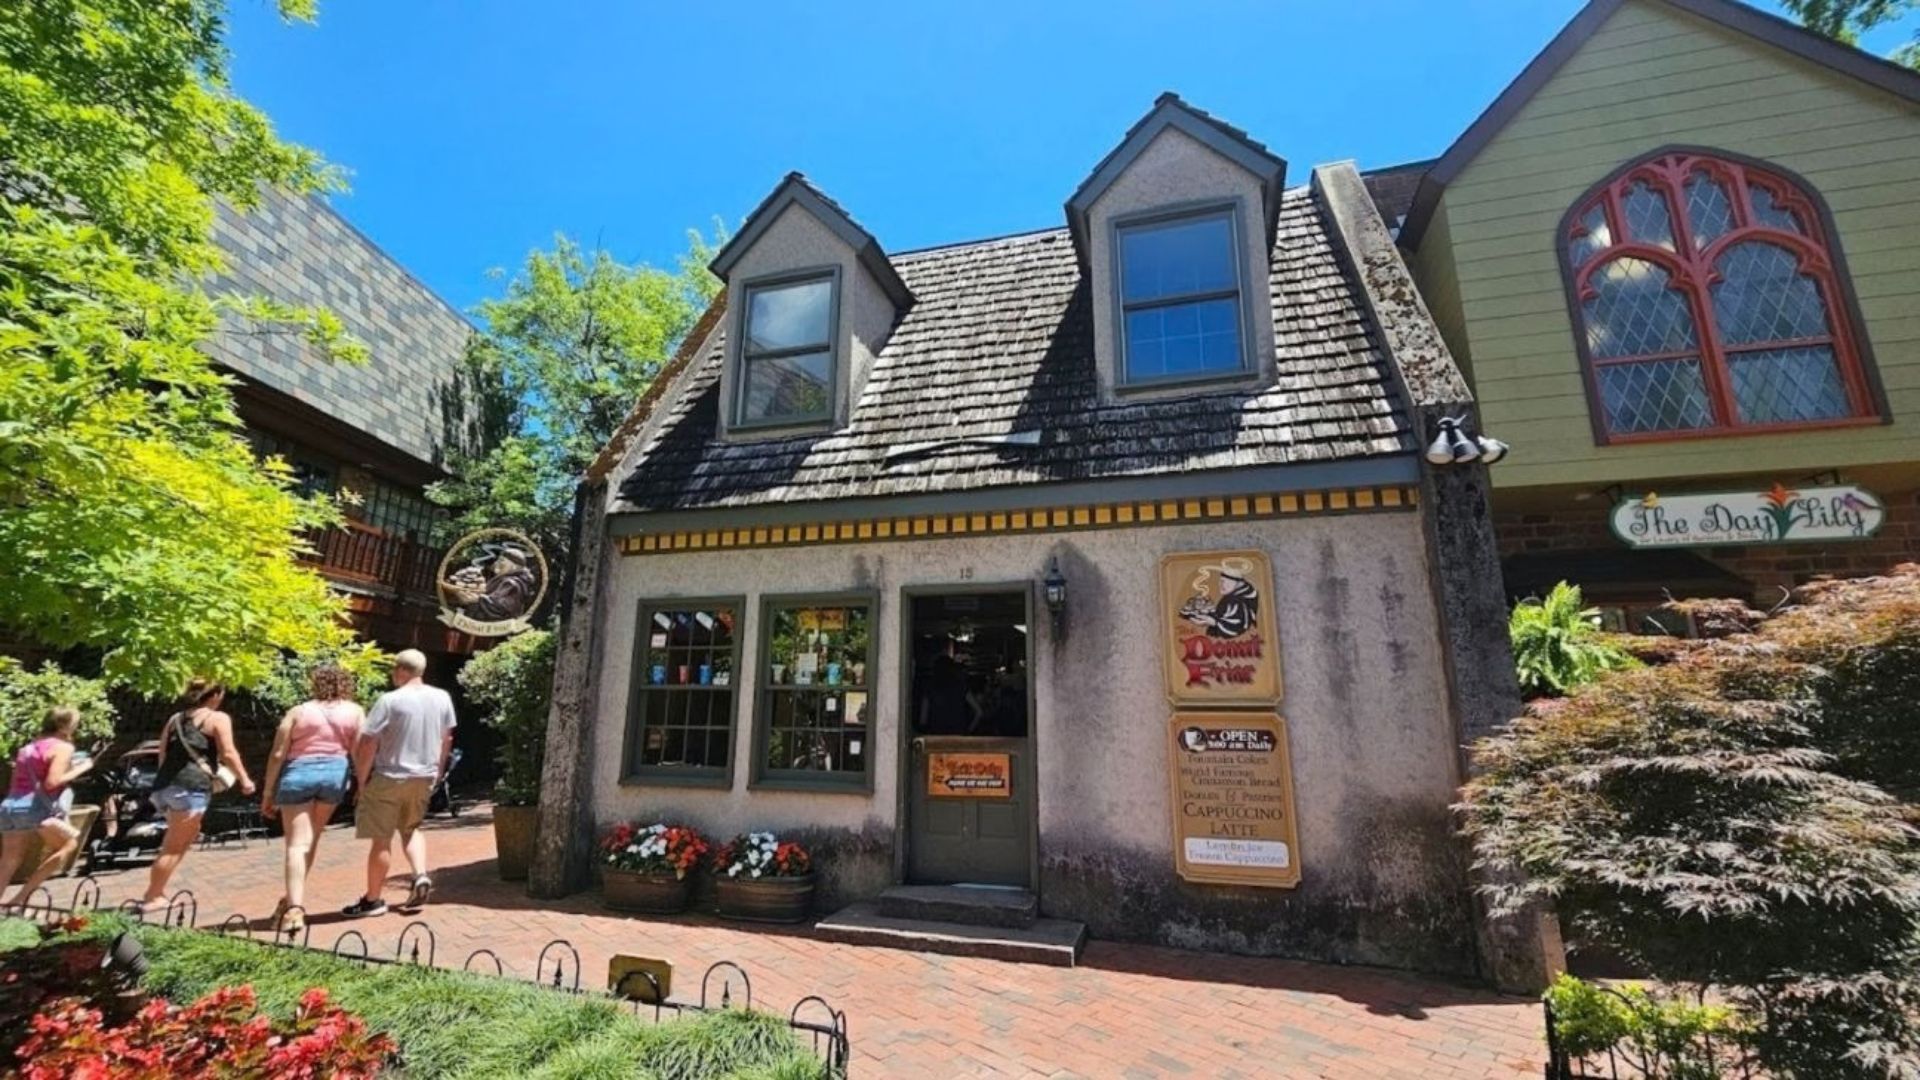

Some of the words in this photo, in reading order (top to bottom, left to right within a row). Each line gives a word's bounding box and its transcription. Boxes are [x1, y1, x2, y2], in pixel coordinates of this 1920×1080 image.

[1630, 503, 1689, 536] The
[1701, 503, 1775, 540] Day
[1796, 497, 1865, 537] Lily
[1179, 632, 1264, 663] Donut
[1185, 660, 1256, 687] Friar
[1220, 730, 1259, 742] OPEN
[1248, 741, 1272, 752] Daily
[1183, 802, 1284, 821] CAPPUCCINO
[1210, 822, 1260, 837] LATTE
